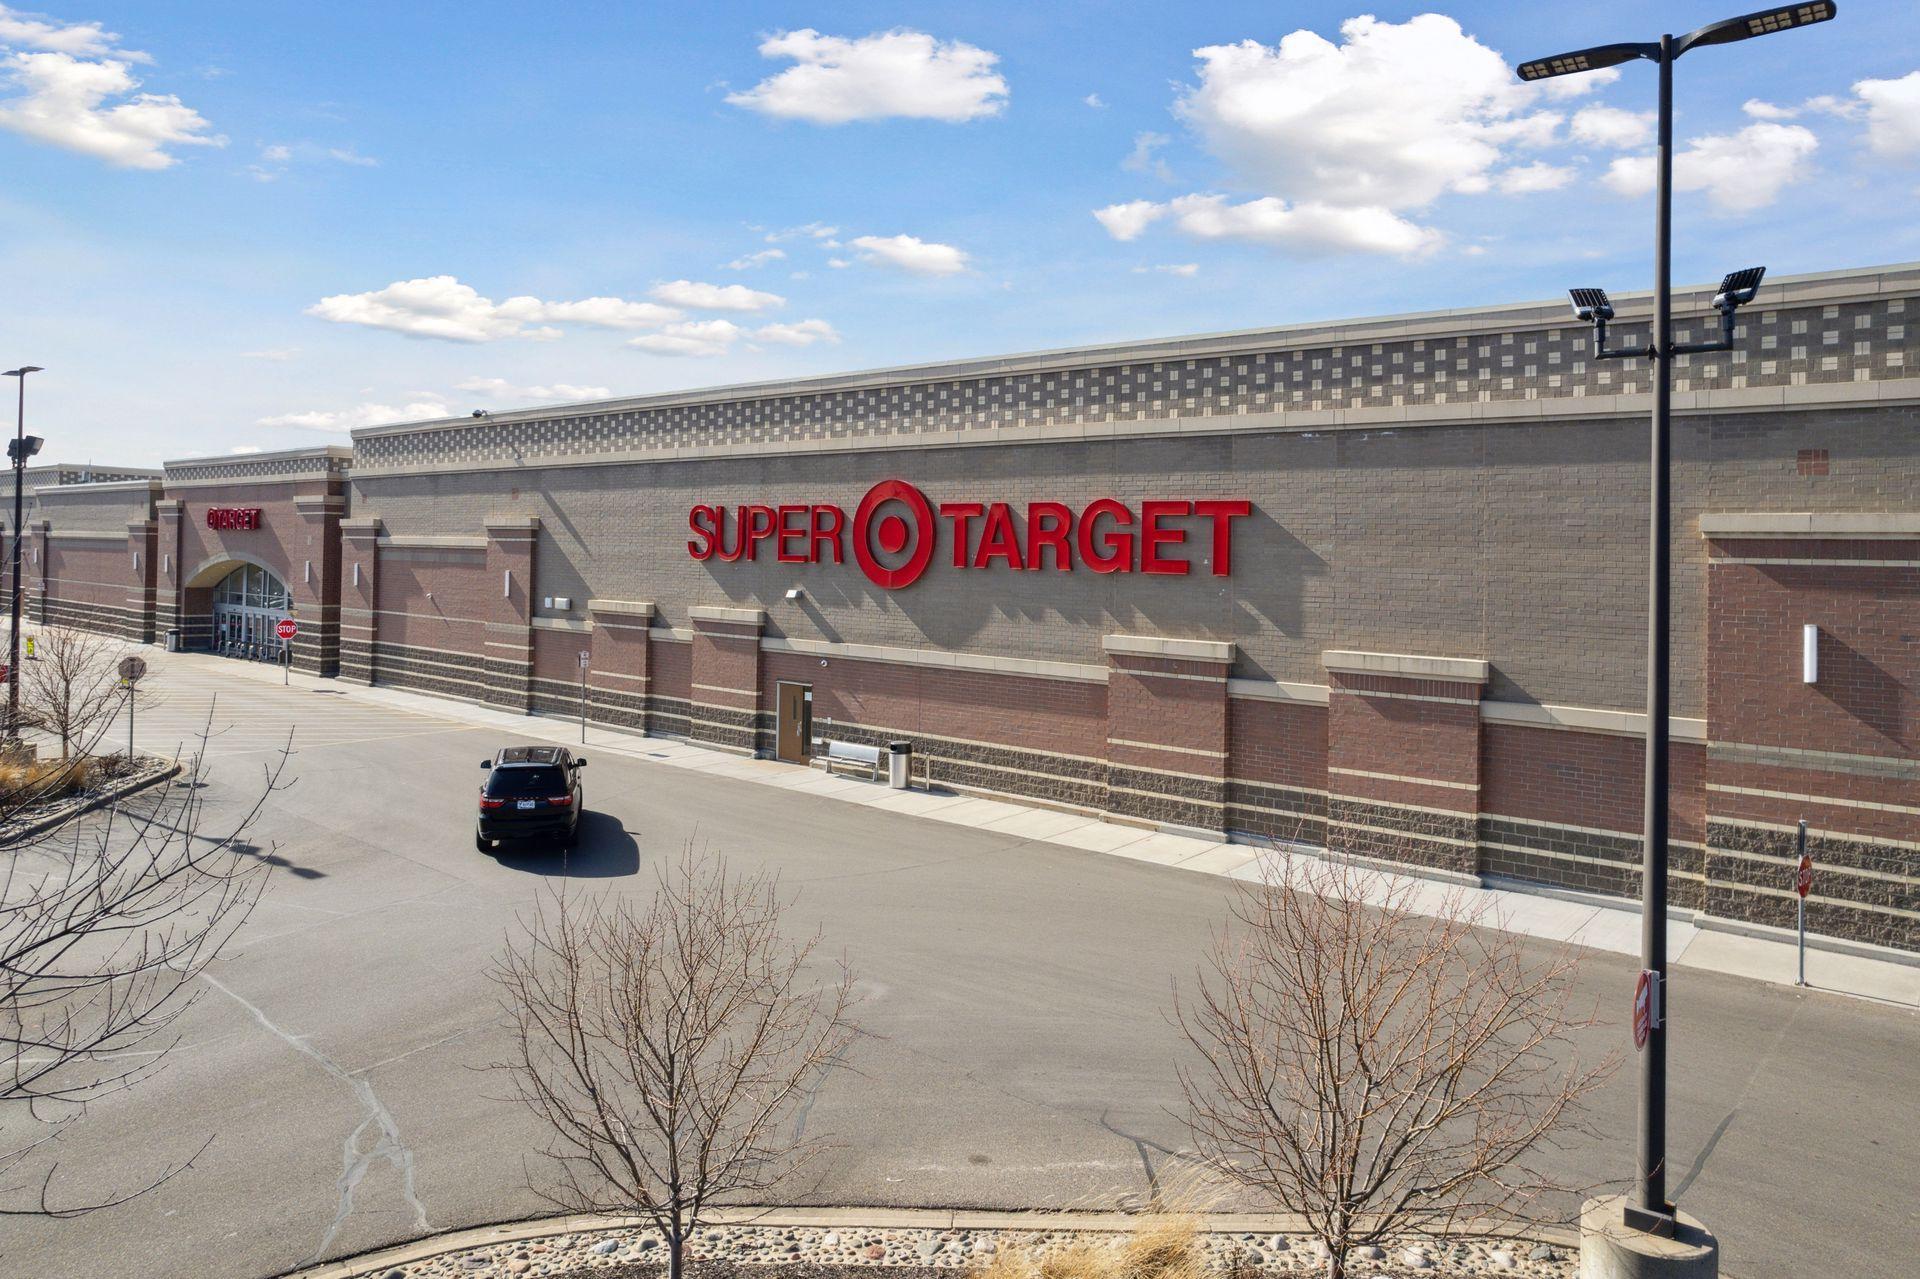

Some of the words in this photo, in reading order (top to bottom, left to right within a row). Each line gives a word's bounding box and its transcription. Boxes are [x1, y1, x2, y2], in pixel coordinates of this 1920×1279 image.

[216, 508, 260, 530] TARGET
[687, 504, 844, 564] SUPER
[940, 498, 1251, 577] TARGET
[278, 625, 296, 633] STOP
